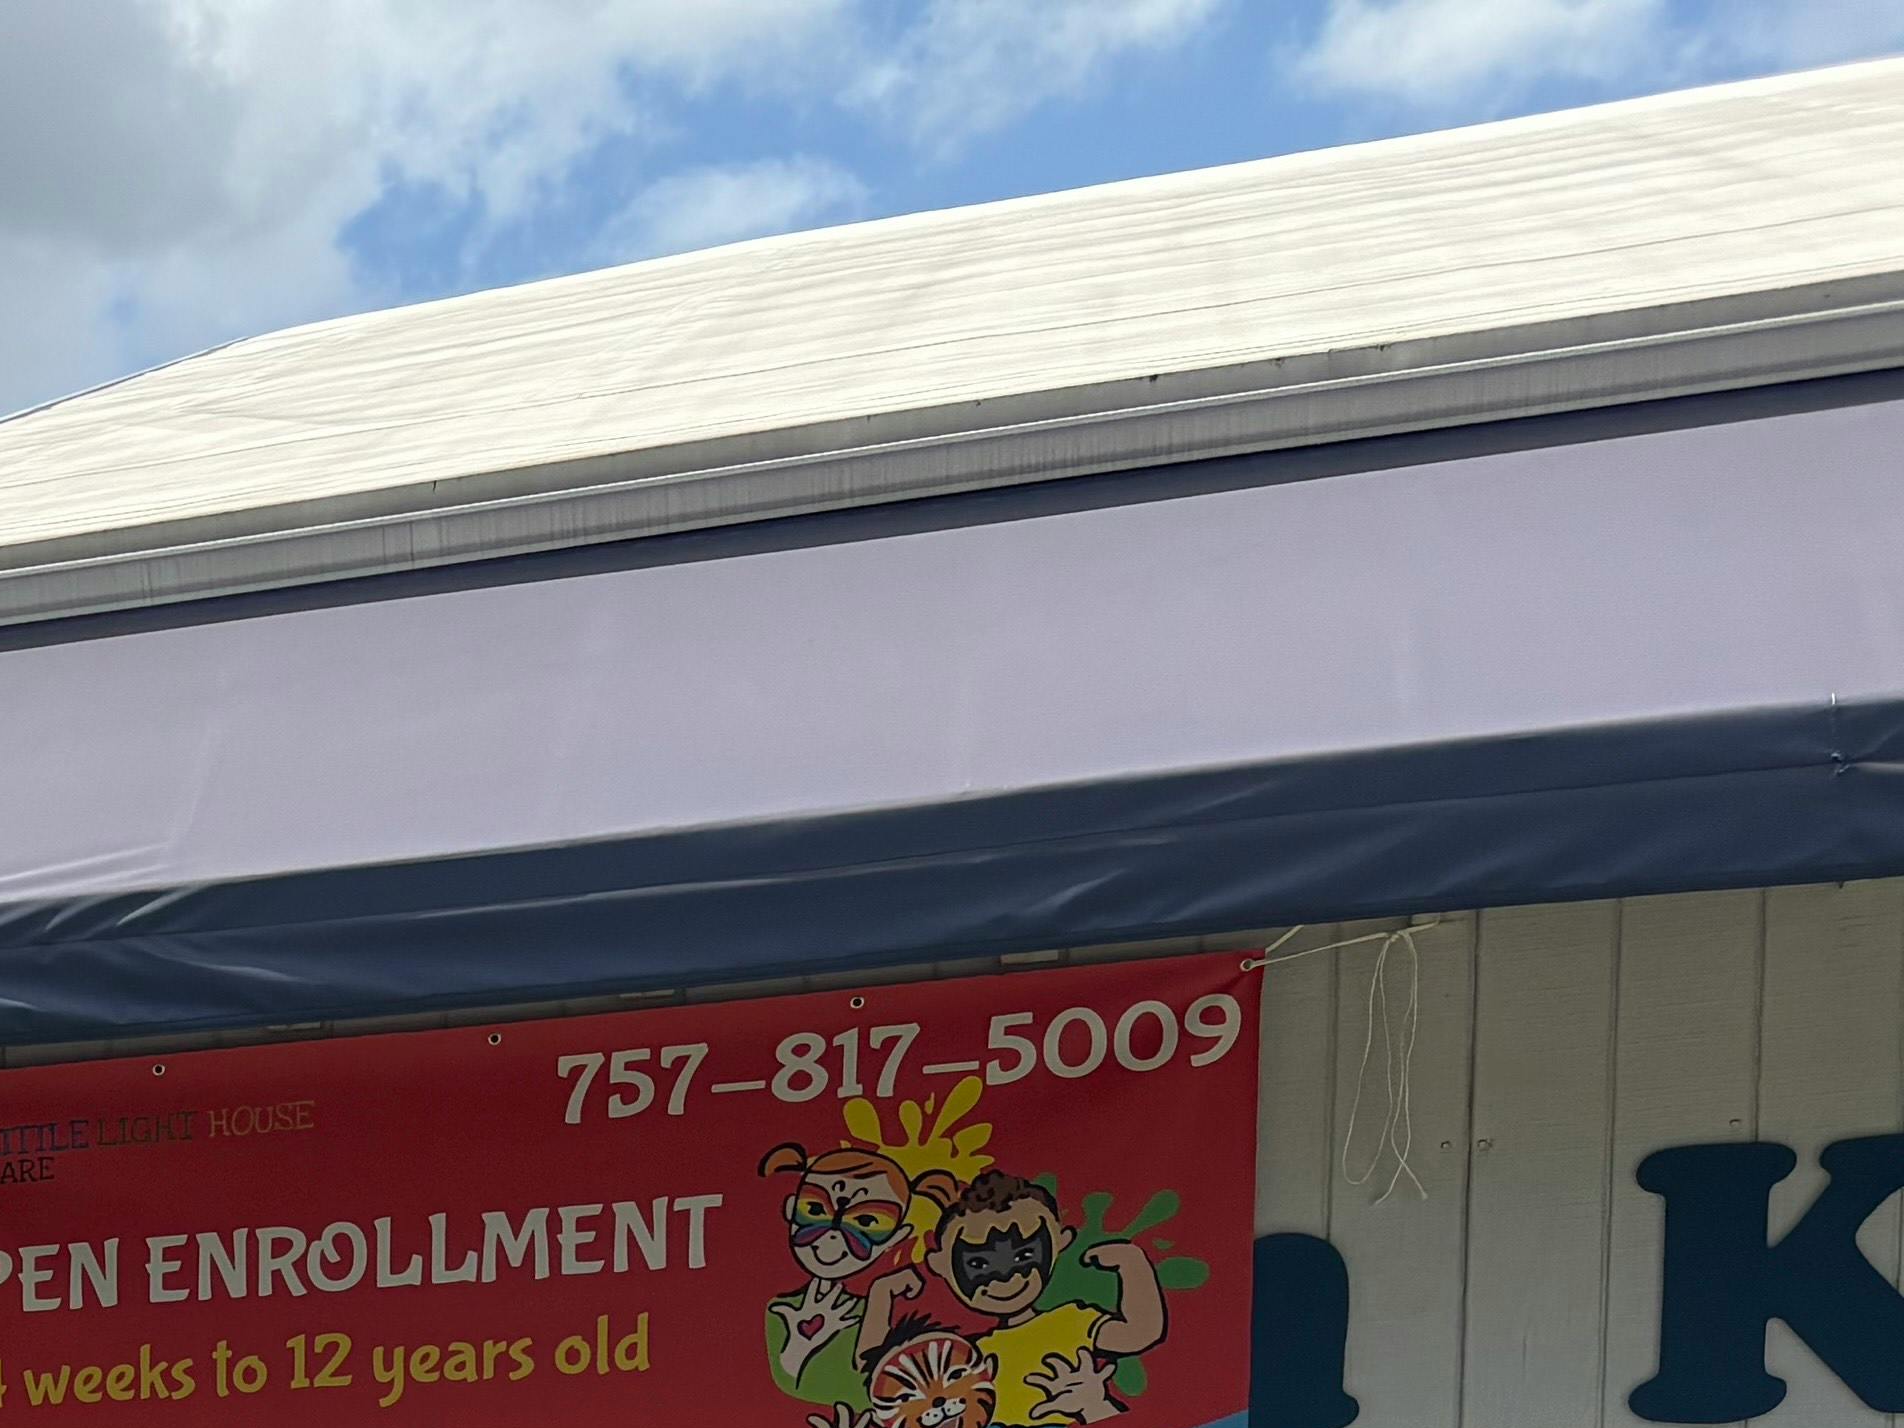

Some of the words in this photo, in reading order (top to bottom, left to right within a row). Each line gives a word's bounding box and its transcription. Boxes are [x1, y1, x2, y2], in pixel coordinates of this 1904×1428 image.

[96, 1110, 199, 1147] LIGHT
[208, 1100, 316, 1139] HOUSE
[146, 1194, 722, 1302] ENROLLMENT
[24, 1344, 195, 1405] weeks
[213, 1340, 267, 1397] to
[287, 1333, 352, 1388] 12
[373, 1338, 534, 1407] years
[555, 1312, 650, 1374] old
